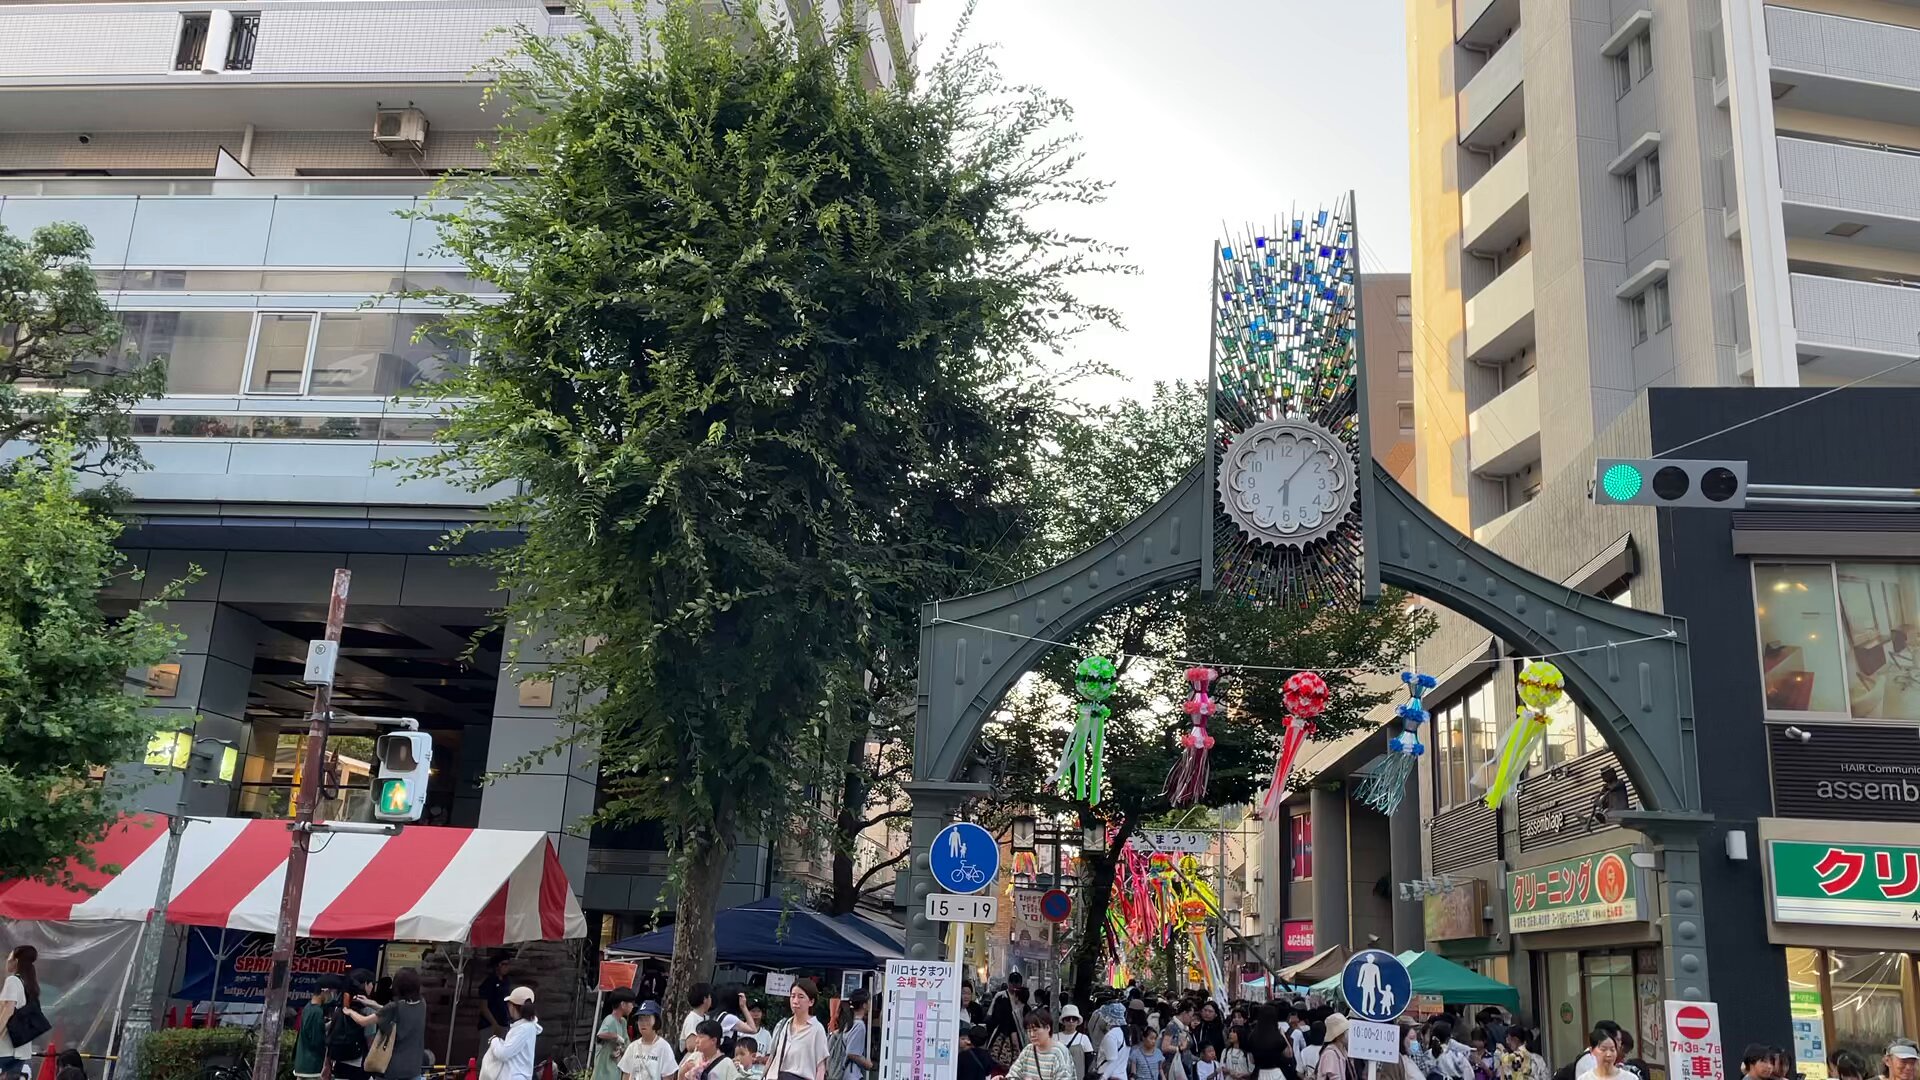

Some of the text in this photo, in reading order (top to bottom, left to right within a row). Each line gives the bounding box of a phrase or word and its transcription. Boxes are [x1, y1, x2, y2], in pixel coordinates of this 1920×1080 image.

[1265, 449, 1274, 462] 11
[1281, 445, 1293, 458] 12
[1251, 461, 1263, 473] 10
[1313, 461, 1321, 474] 2
[1247, 476, 1256, 489] 9
[1317, 478, 1326, 490] 3
[1251, 493, 1261, 505] 8
[1312, 494, 1322, 506] 4
[1266, 506, 1275, 518] 7
[1282, 509, 1290, 522] 6
[1299, 506, 1307, 519] 5
[1840, 763, 1866, 773] HAIR
[1817, 779, 1920, 802] assemb
[1527, 812, 1563, 836] assemblage
[1813, 847, 1920, 899] クリ
[1513, 858, 1593, 912] クリーニング
[291, 957, 346, 976] SCHOOL
[891, 964, 952, 978] 川口七夕まつり
[896, 976, 945, 989] 会場マップ
